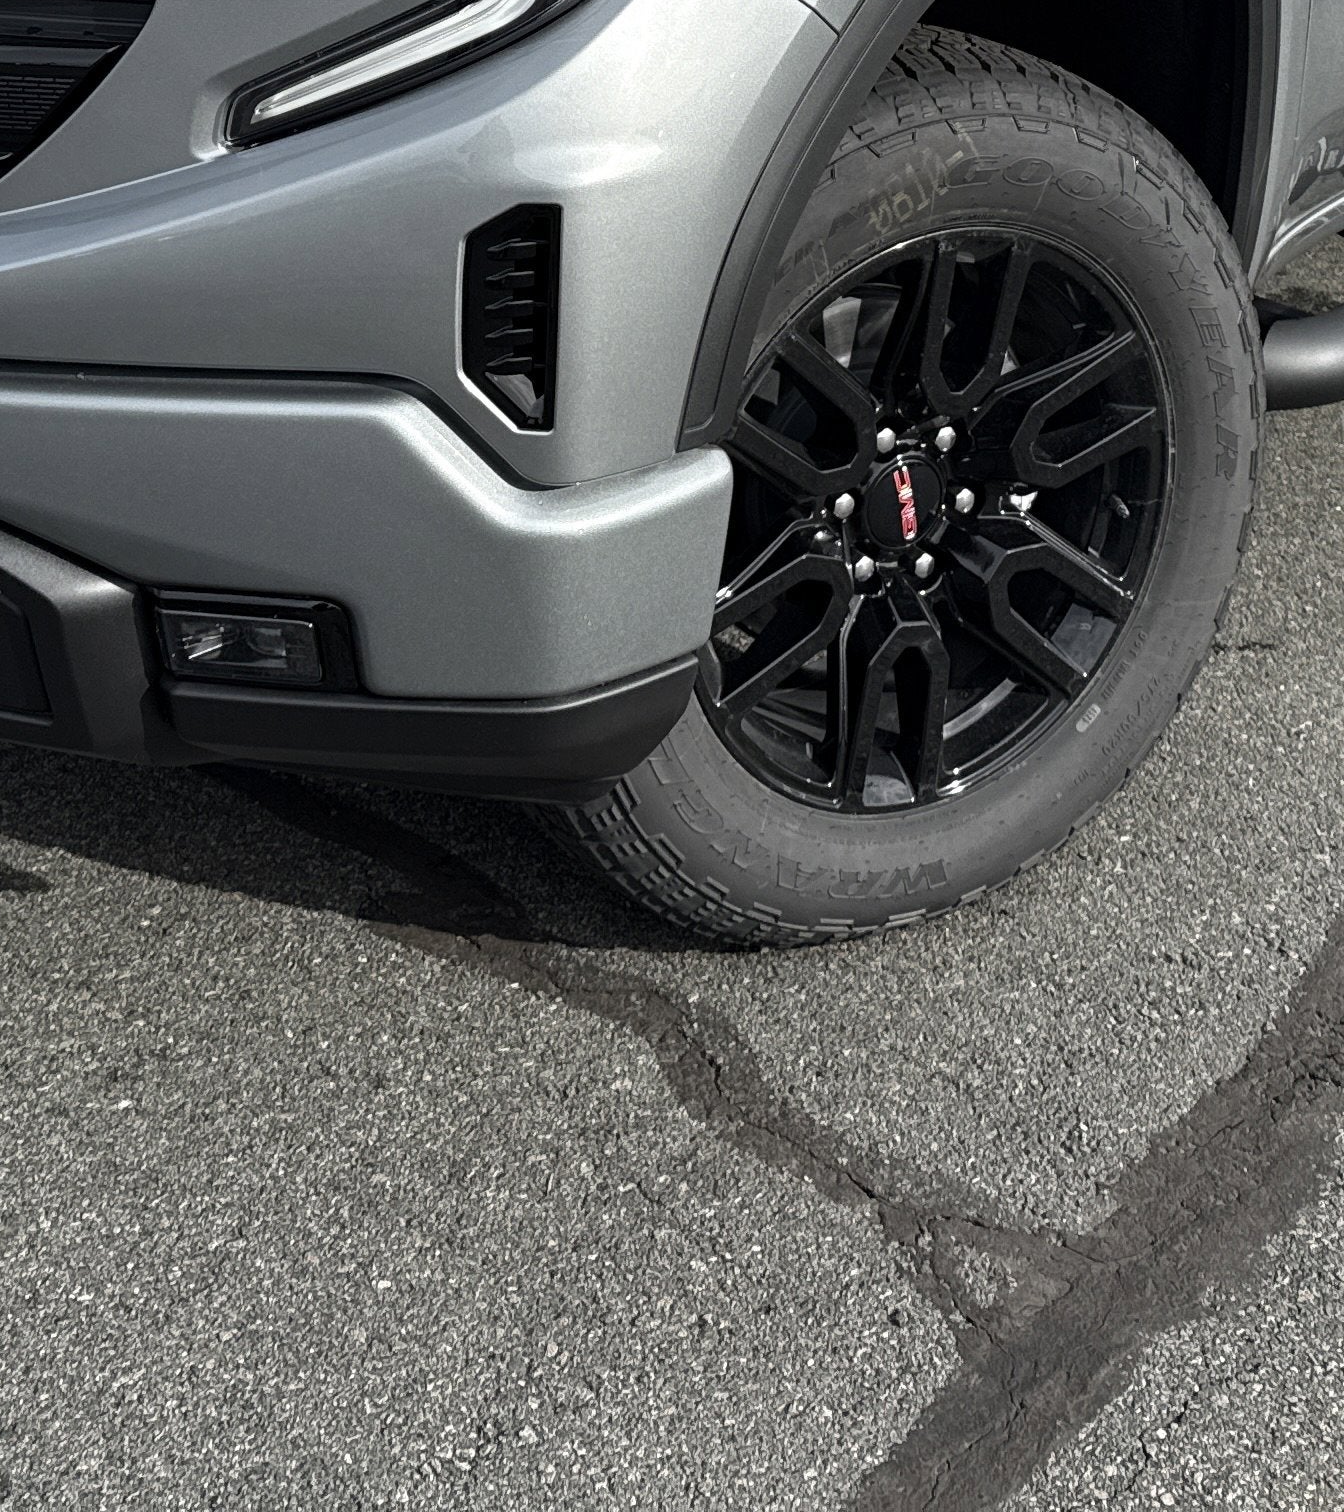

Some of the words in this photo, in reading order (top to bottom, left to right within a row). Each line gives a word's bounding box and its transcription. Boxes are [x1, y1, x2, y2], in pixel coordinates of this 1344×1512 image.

[944, 152, 1239, 481] GOODYEAR
[893, 466, 917, 540] GMC
[648, 734, 947, 899] WRANGL
